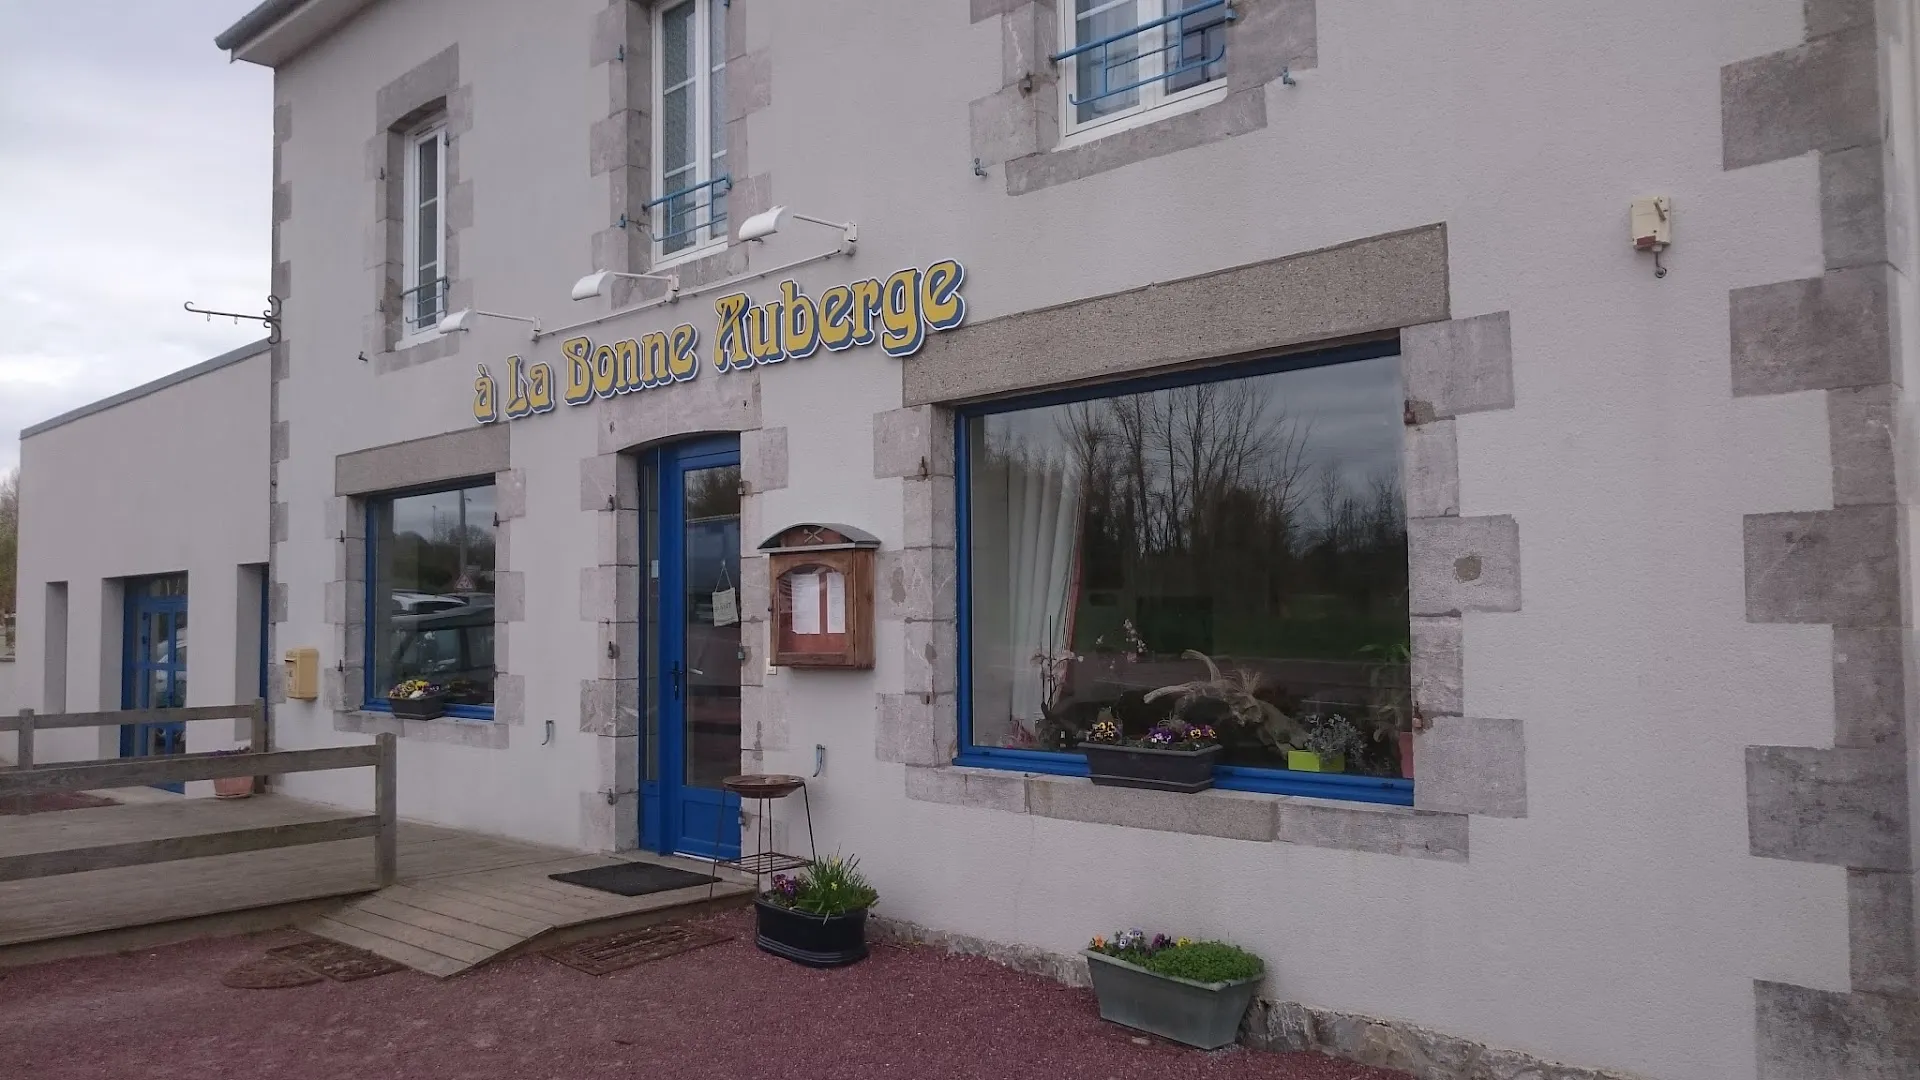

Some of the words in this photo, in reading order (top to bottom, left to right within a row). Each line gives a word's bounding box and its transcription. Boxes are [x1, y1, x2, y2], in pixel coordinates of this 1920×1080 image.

[473, 364, 497, 423] à
[504, 355, 555, 419] La
[561, 321, 699, 405] Bonne
[713, 258, 967, 373] Auberge
